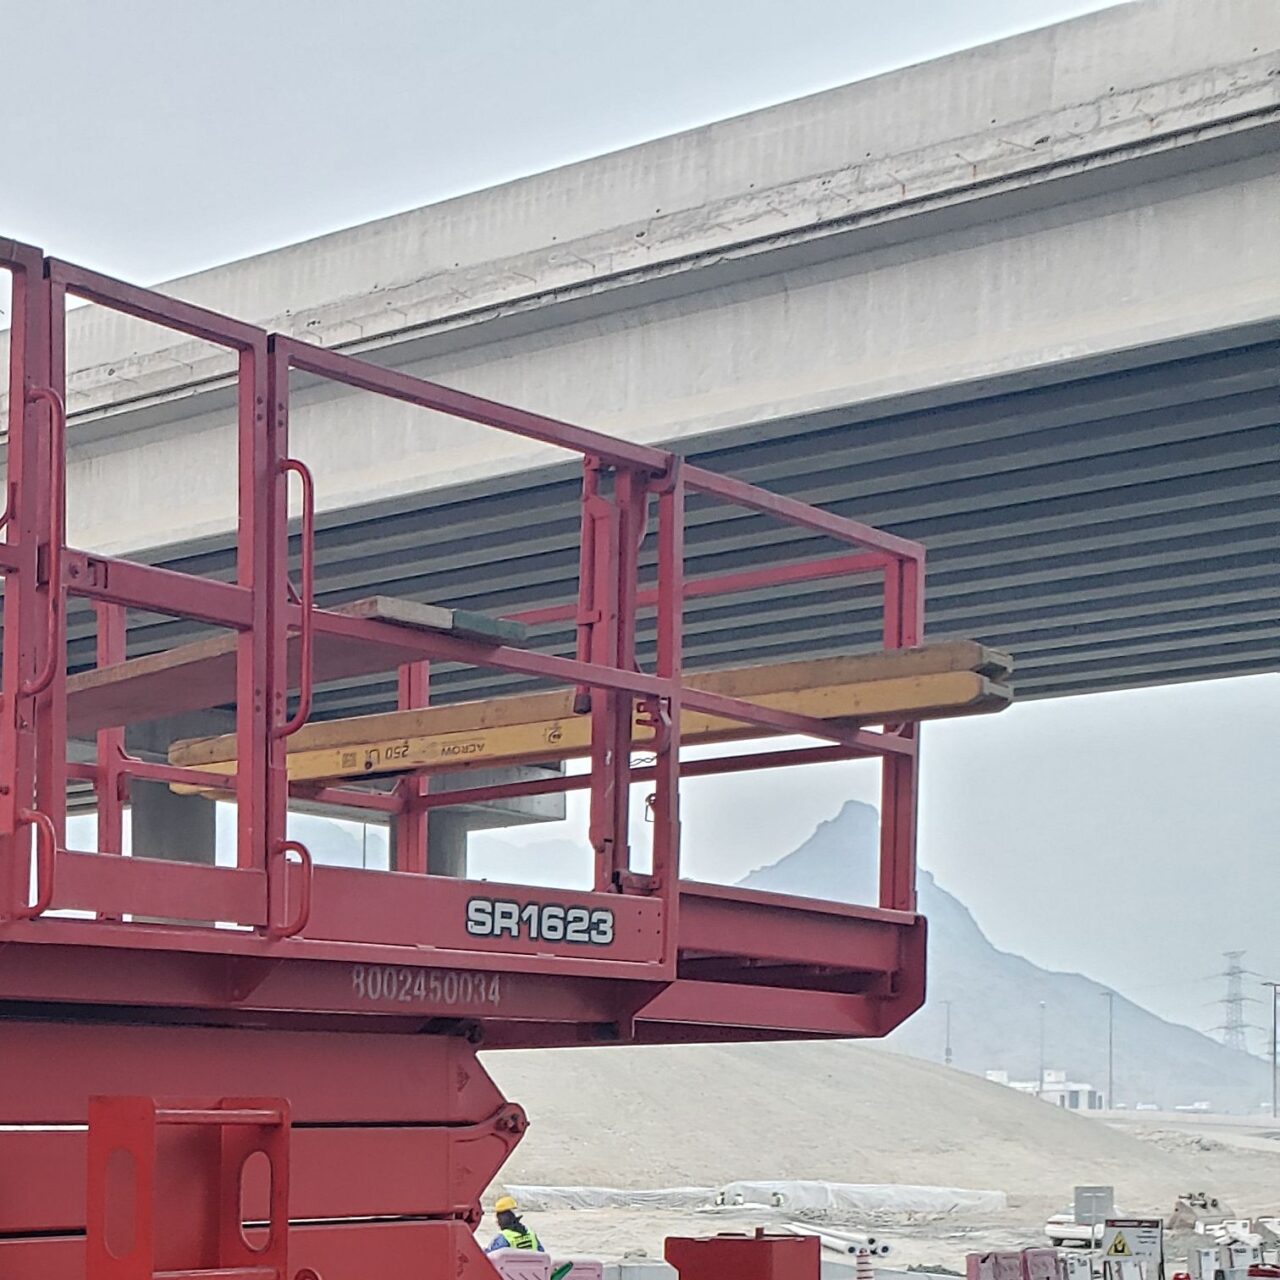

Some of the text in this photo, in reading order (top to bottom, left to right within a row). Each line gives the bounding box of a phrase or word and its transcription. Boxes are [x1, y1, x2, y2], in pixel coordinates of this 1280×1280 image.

[385, 745, 410, 760] 250
[441, 743, 486, 757] ACROW
[467, 899, 614, 944] SR1623
[352, 966, 501, 1006] 8002450034
